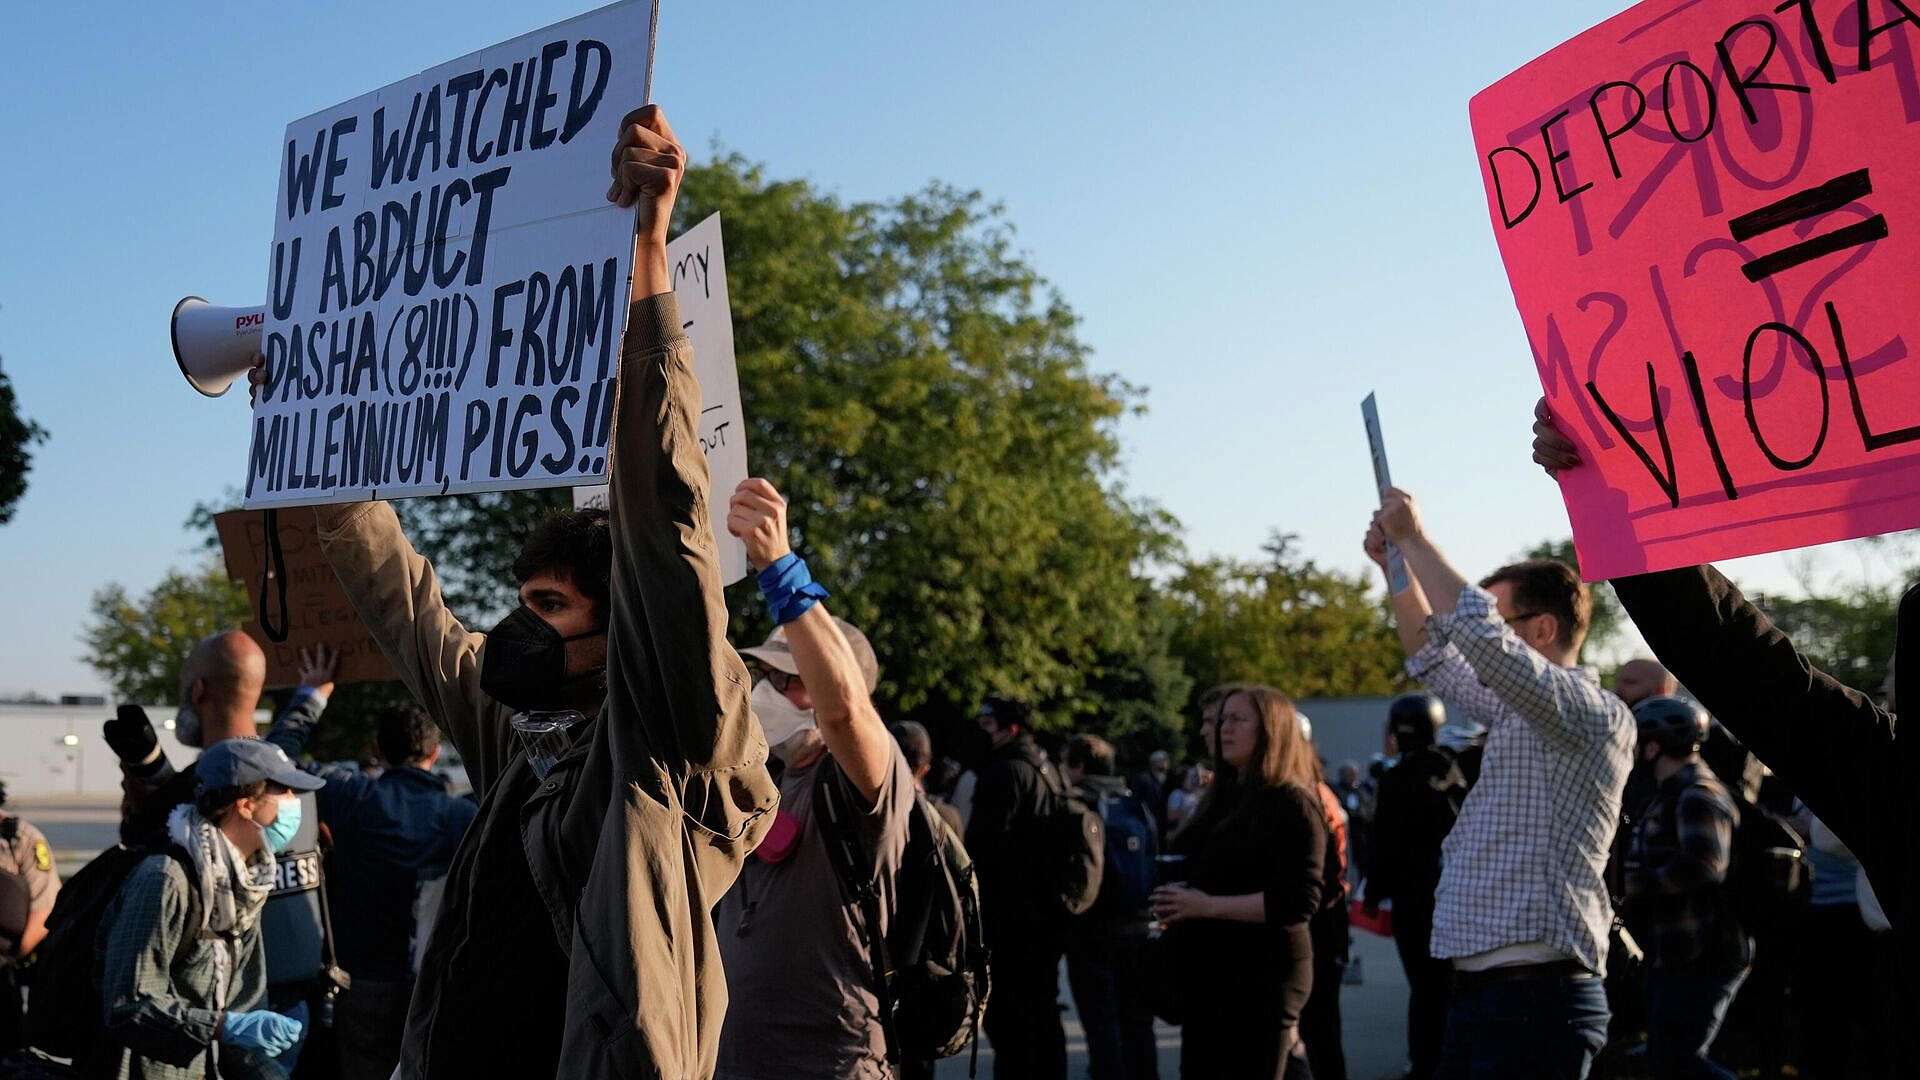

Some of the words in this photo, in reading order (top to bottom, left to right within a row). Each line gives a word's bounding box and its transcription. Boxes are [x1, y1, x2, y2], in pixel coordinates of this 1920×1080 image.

[288, 116, 357, 222] WE
[370, 39, 613, 191] WATCHED
[273, 237, 301, 320] U
[319, 166, 512, 314] ABDUCT
[486, 257, 617, 388] FROM
[245, 391, 451, 500] MILLENNIUM,
[460, 377, 617, 481] PIGS!!
[1585, 301, 1920, 508] VIOL
[273, 856, 318, 891] RESS
